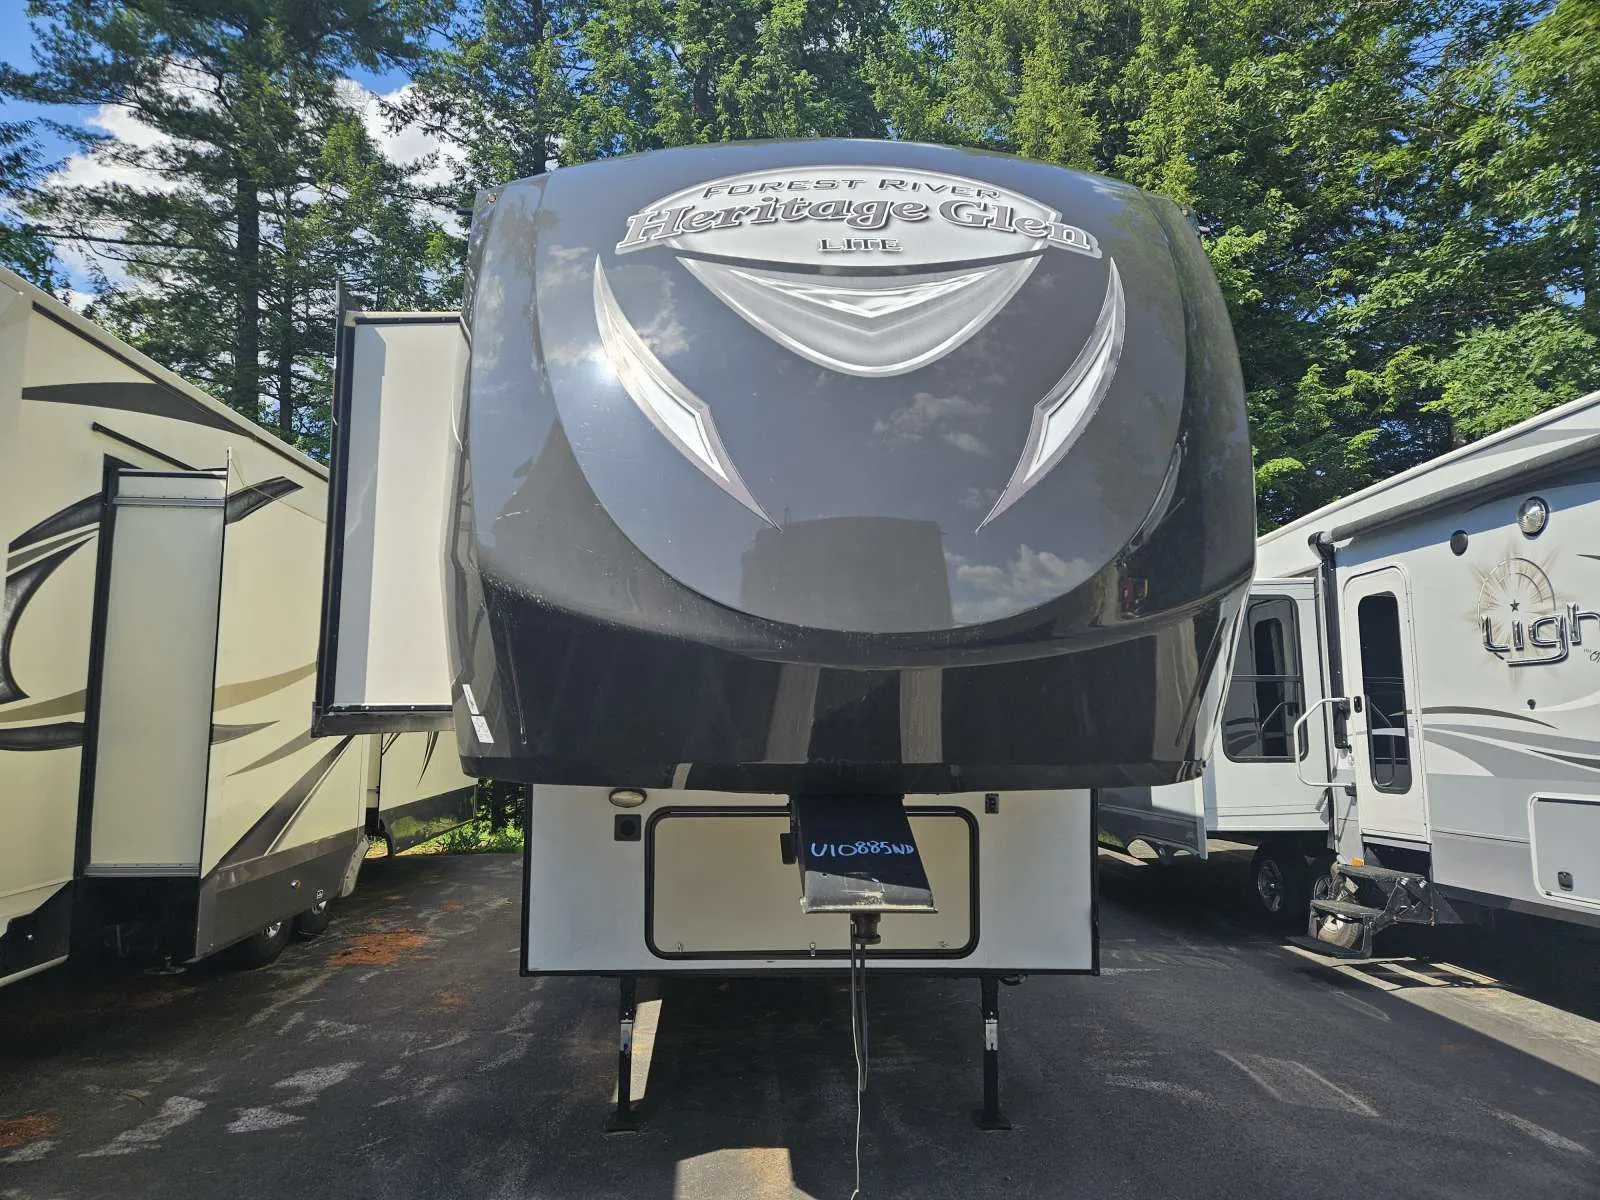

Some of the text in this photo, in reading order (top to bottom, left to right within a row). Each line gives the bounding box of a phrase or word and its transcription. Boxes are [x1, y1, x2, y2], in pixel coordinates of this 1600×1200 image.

[702, 178, 1001, 200] FOREST RIVER
[615, 195, 1092, 250] Heritage Glen
[819, 238, 903, 252] LITE
